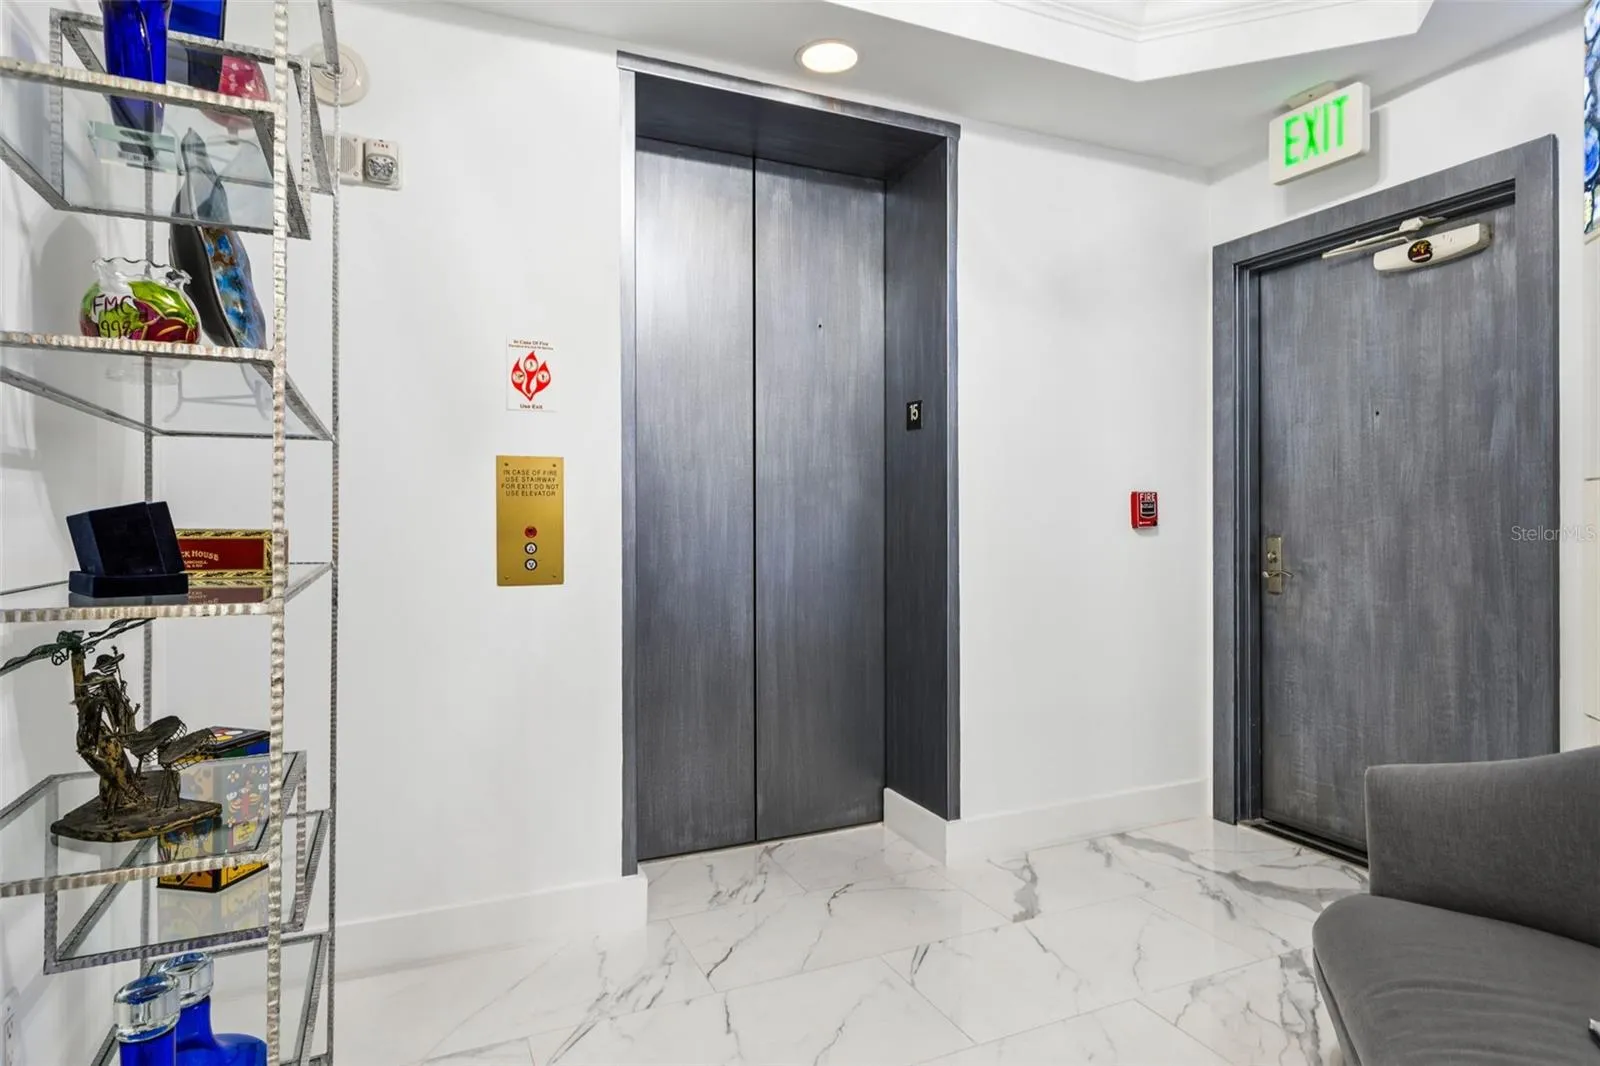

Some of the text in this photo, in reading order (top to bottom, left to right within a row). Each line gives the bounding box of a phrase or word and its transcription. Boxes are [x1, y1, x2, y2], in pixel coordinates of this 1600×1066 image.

[1284, 93, 1349, 167] EXIT
[93, 294, 132, 316] FMC
[909, 403, 919, 421] 15
[1139, 492, 1156, 502] FIRE
[191, 550, 219, 561] HOUSE
